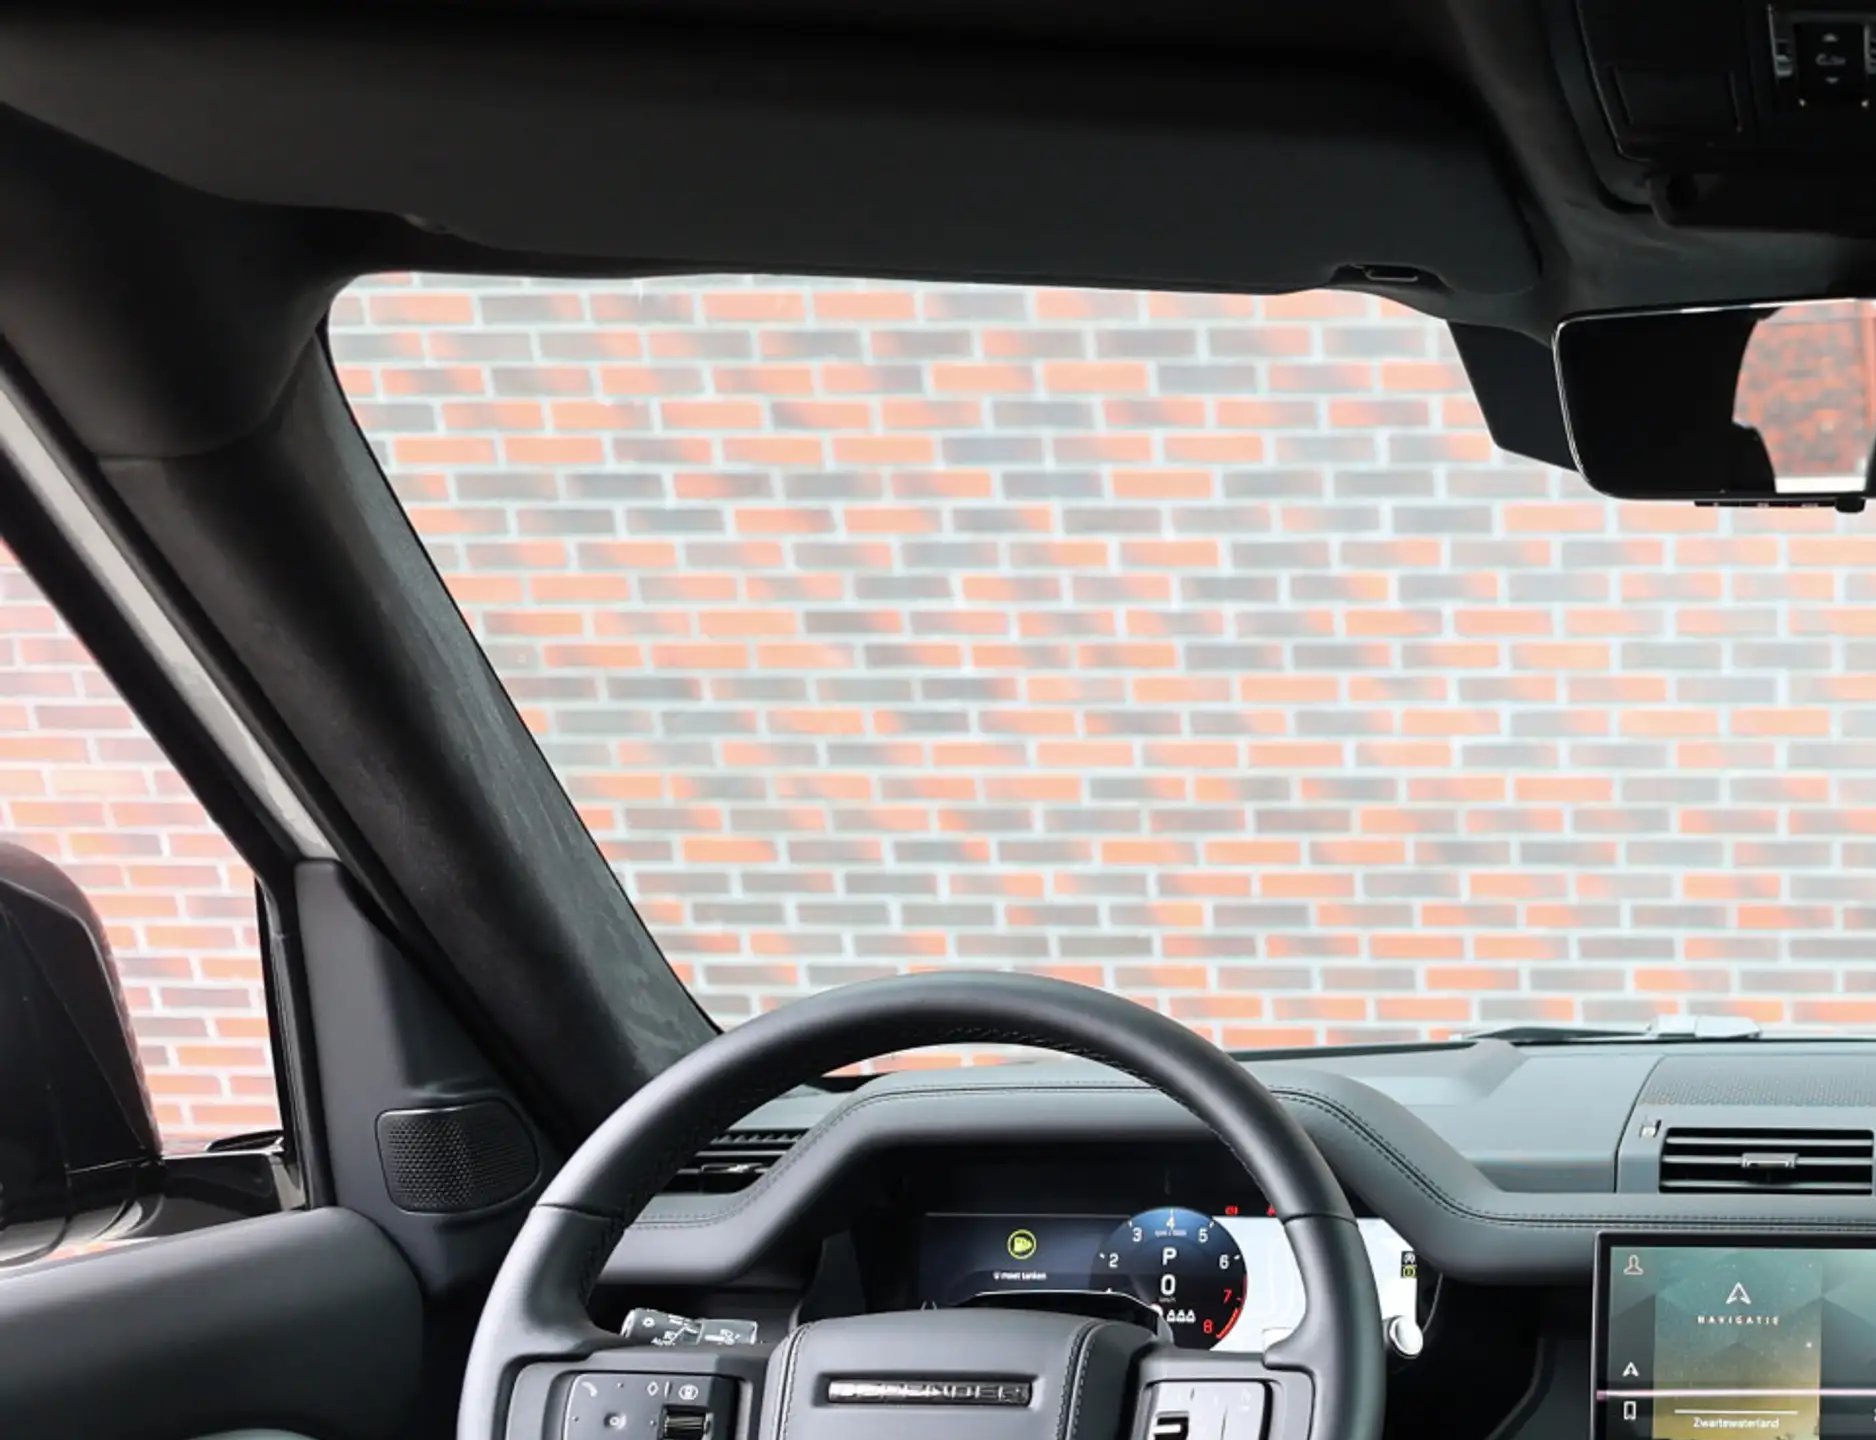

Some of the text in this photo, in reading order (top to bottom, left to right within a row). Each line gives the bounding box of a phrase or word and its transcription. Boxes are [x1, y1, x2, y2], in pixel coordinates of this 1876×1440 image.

[1132, 1227, 1142, 1243] 3
[1199, 1228, 1208, 1243] 5
[1109, 1253, 1119, 1268] 2
[1162, 1247, 1177, 1266] P
[1219, 1254, 1229, 1270] 6
[1160, 1274, 1176, 1296] 0
[1223, 1289, 1233, 1303] 7
[1203, 1319, 1213, 1334] 8
[1697, 1315, 1779, 1326] NAVIGATIE
